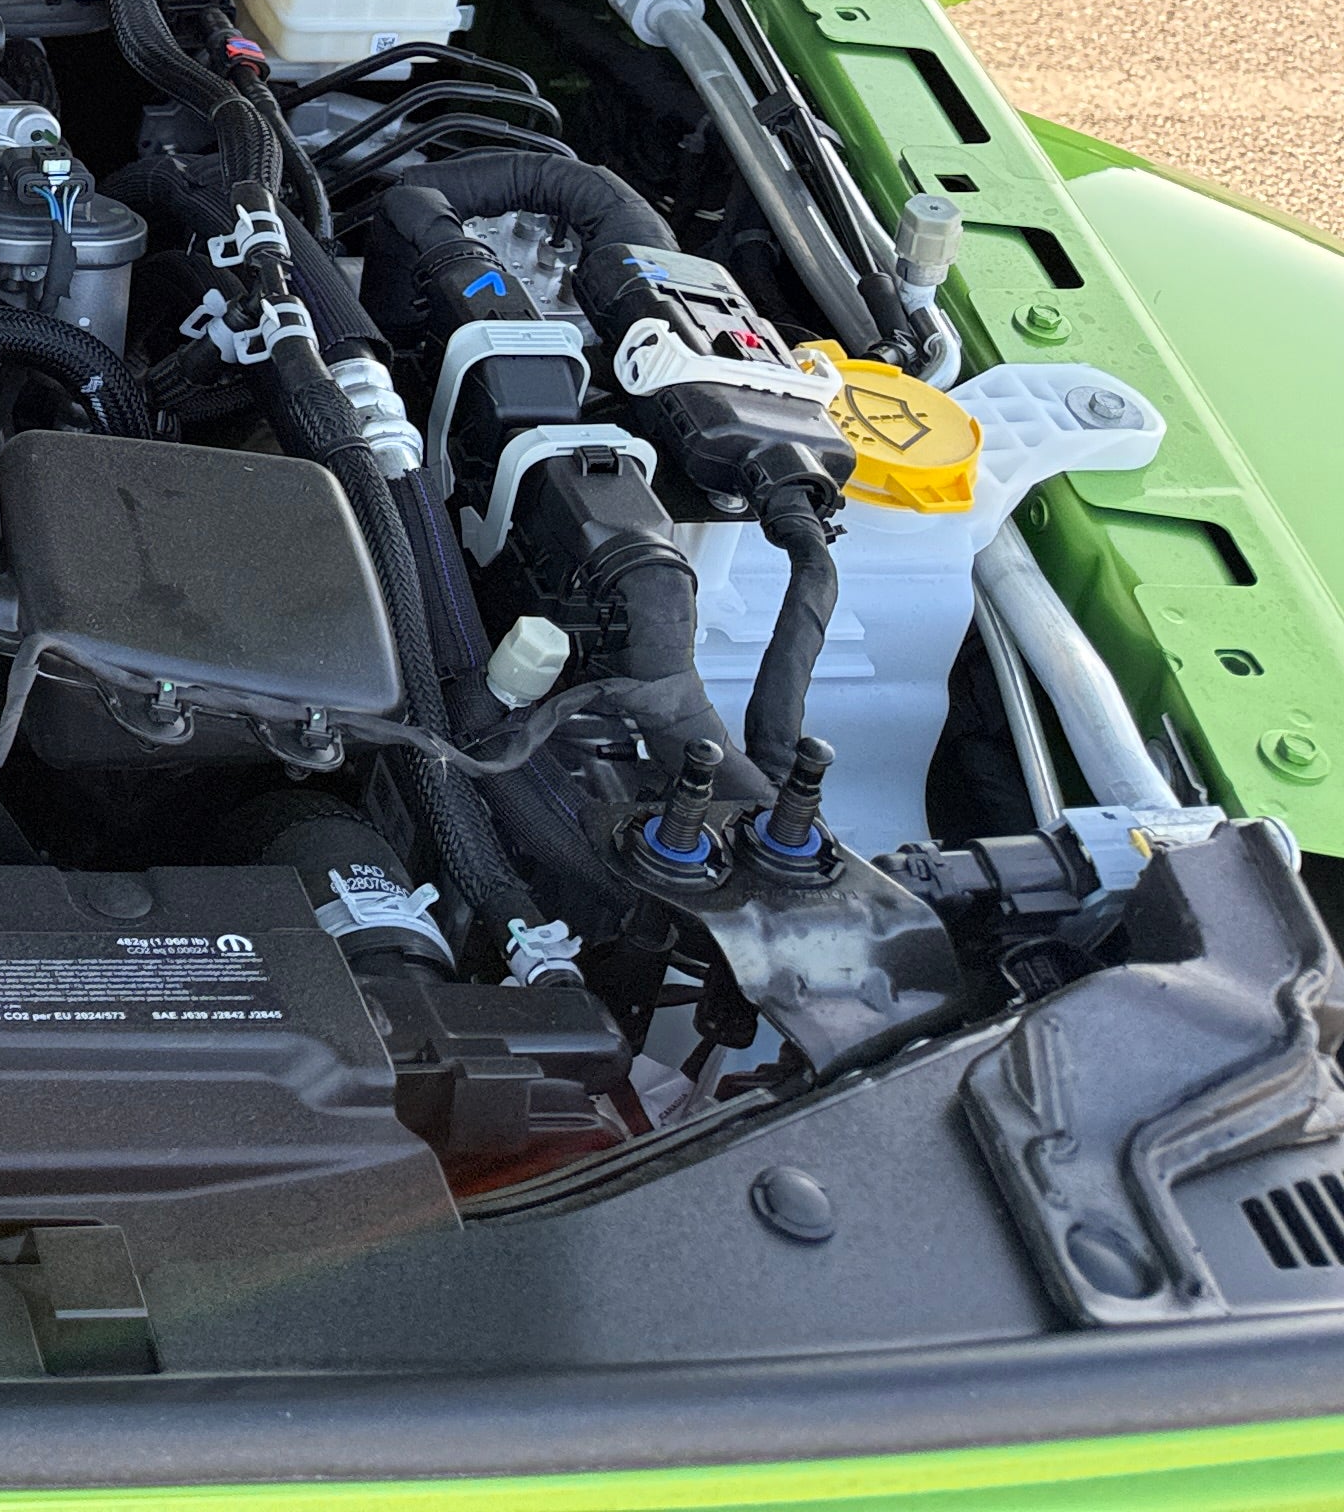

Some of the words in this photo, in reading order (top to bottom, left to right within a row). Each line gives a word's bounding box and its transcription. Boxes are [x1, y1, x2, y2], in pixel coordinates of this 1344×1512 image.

[350, 864, 385, 878] RAD
[191, 937, 209, 947] lb)
[4, 1011, 29, 1021] CO2
[32, 1012, 51, 1022] per
[54, 1011, 71, 1021] EU
[74, 1011, 126, 1021] 2024/573
[151, 1011, 179, 1020] SAE
[180, 1011, 209, 1020] J639
[210, 1011, 246, 1020] J2842
[247, 1010, 283, 1020] J2845
